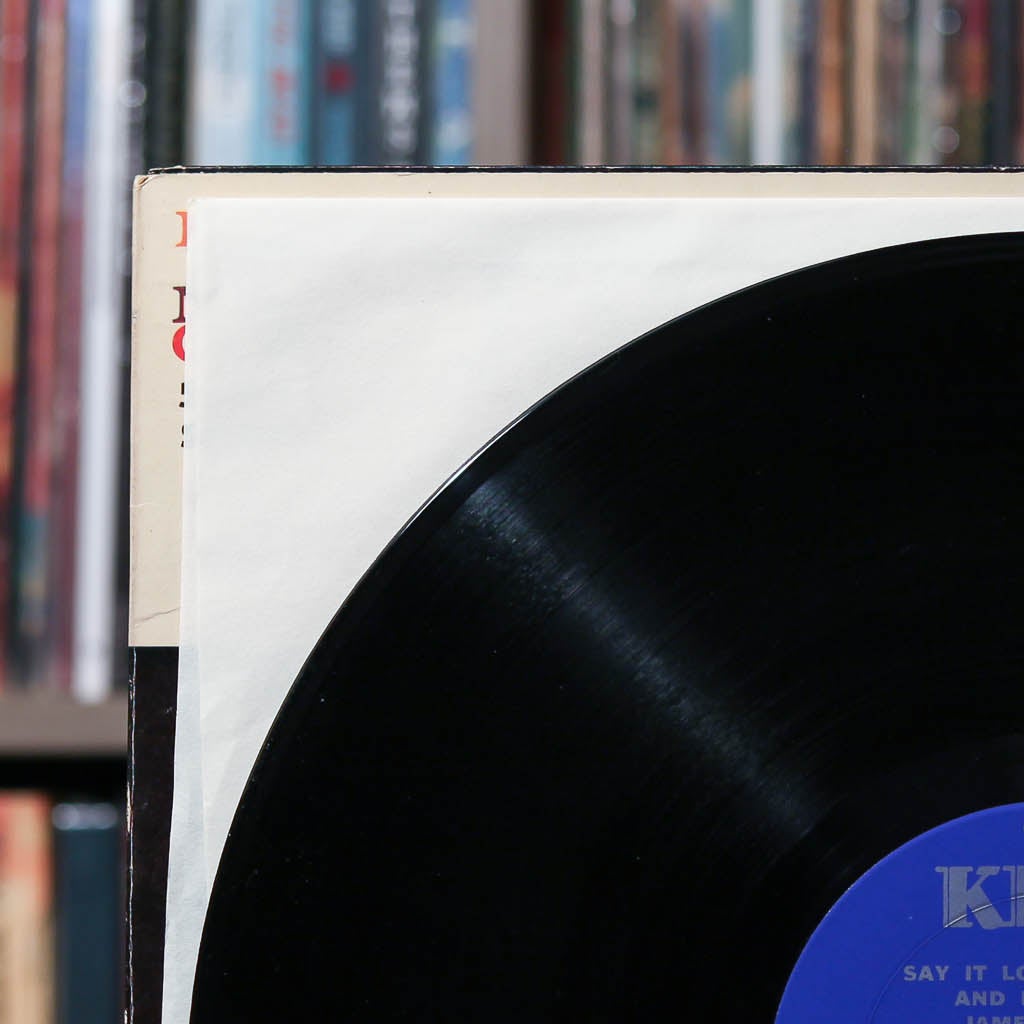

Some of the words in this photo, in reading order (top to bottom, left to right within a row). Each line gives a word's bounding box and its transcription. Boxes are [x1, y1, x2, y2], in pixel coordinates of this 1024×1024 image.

[903, 965, 949, 982] SAY
[965, 965, 988, 982] IT
[954, 990, 1005, 1006] AND
